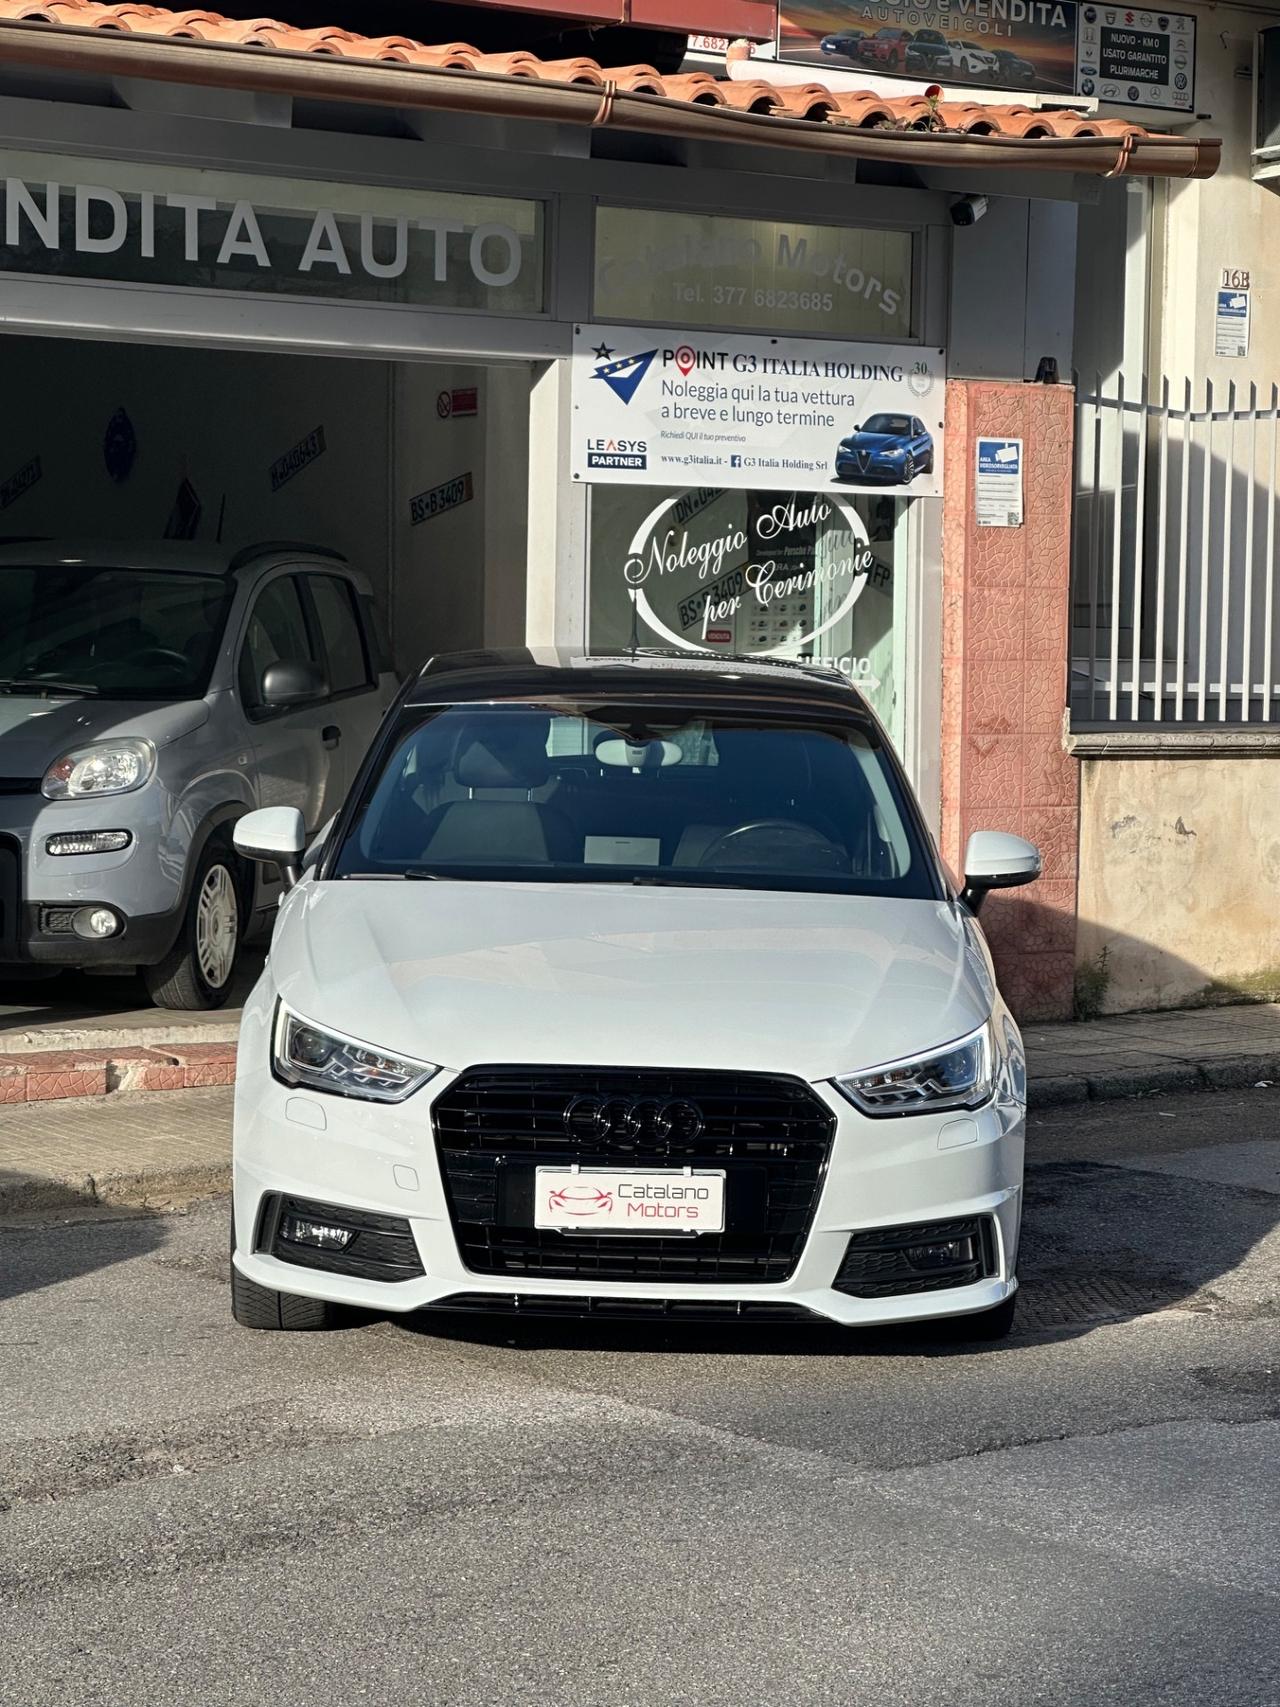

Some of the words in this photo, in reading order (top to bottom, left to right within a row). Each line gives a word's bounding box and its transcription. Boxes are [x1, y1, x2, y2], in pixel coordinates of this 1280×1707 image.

[861, 6, 1012, 37] AUTOVEICOLI
[958, 0, 1067, 28] VENDITA
[1111, 33, 1135, 45] NUOVO
[1103, 48, 1126, 60] USATO
[1127, 51, 1167, 64] GARANTITO
[1110, 65, 1158, 79] PLURIMARCHE
[6, 177, 271, 267] NDITA
[298, 209, 522, 287] AUTO
[778, 234, 900, 315] Motors
[1224, 270, 1250, 288] 16B
[673, 282, 703, 302] Tel.
[713, 286, 747, 305] 377
[754, 288, 833, 311] 6823685
[662, 346, 729, 376] POINT
[733, 353, 758, 374] G3
[763, 357, 821, 378] ITALIA
[824, 361, 903, 383] HOLDING
[914, 361, 928, 375] 30
[661, 379, 728, 401] Noleggia
[731, 384, 755, 402] qui
[758, 385, 772, 402] la
[774, 389, 799, 404] tua
[801, 391, 855, 406] vettura
[661, 406, 670, 418] a
[674, 402, 716, 421] breve
[719, 409, 729, 421] e
[732, 405, 773, 426] lungo
[777, 410, 835, 427] termine
[660, 430, 684, 440] Richiedi
[686, 432, 698, 440] QUI
[703, 433, 715, 441] tuo
[715, 434, 746, 442] preventivo
[587, 438, 647, 453] LEASYS
[592, 456, 642, 467] PARTNER
[661, 454, 722, 466] www.g3italia.it
[743, 456, 756, 467] G3
[758, 457, 780, 468] Italia
[782, 459, 814, 471] Holding
[815, 460, 828, 470] Srl
[624, 523, 748, 583] Noleggio
[756, 491, 832, 539] Auto
[702, 595, 742, 640] per
[745, 542, 874, 607] Cerimonie
[618, 1184, 709, 1200] Catalano
[627, 1203, 698, 1218] Motors
